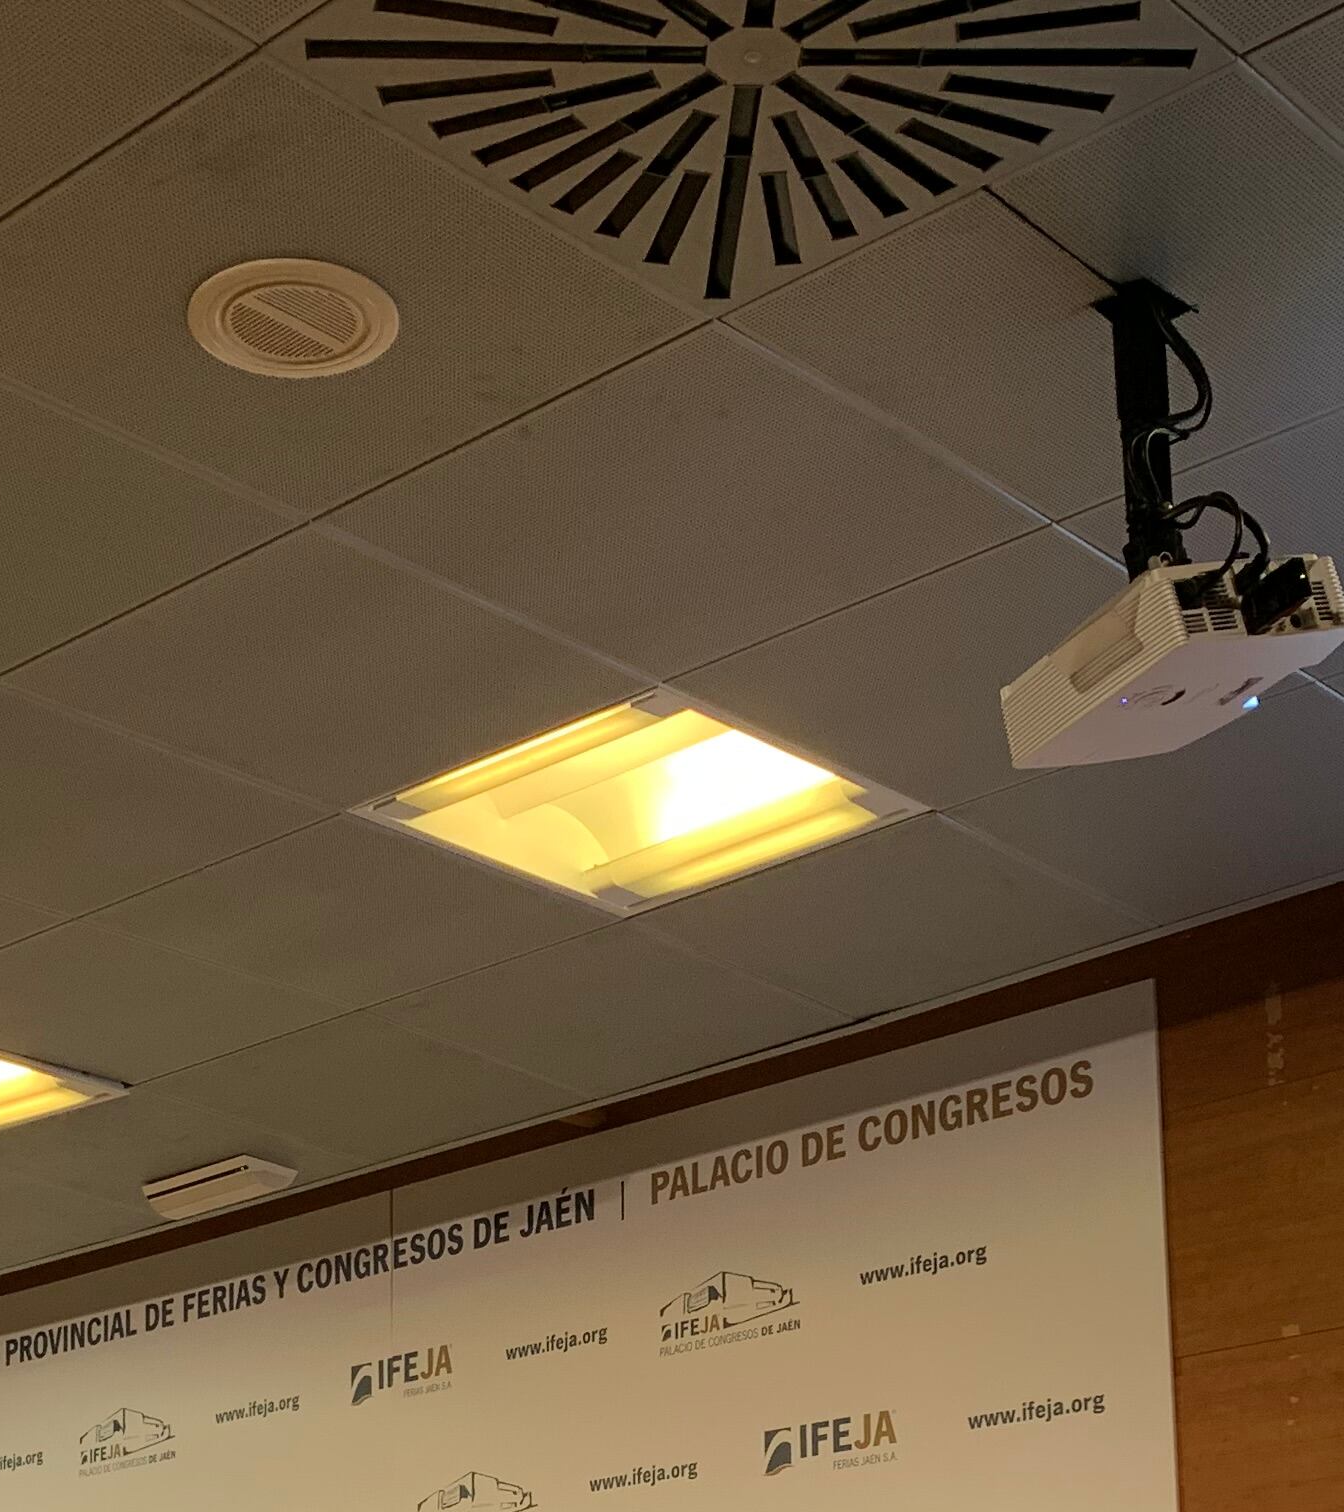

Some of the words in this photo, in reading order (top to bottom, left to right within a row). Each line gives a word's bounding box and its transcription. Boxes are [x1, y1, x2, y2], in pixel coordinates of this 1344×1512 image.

[6, 1309, 137, 1366] PROVINCIAL
[145, 1299, 174, 1332] DE
[183, 1275, 266, 1322] FERIAS
[273, 1268, 290, 1299] Y
[296, 1223, 464, 1293] CONGRESOS
[473, 1211, 509, 1249] DE
[520, 1187, 595, 1238] JAÉN
[651, 1140, 789, 1204] PALACIO
[801, 1124, 847, 1167] DE
[858, 1060, 1094, 1152] CONGRESOS
[860, 1244, 987, 1286] www.ifeja.org
[675, 1314, 720, 1339] IFEJA
[761, 1324, 774, 1336] DE
[506, 1327, 608, 1360] www.ifeja.org
[378, 1345, 453, 1390] IFEJA
[215, 1394, 300, 1424] www.ifeja.org
[968, 1394, 1105, 1430] www.ifeja.org
[589, 1461, 699, 1493] www.ifeja.org
